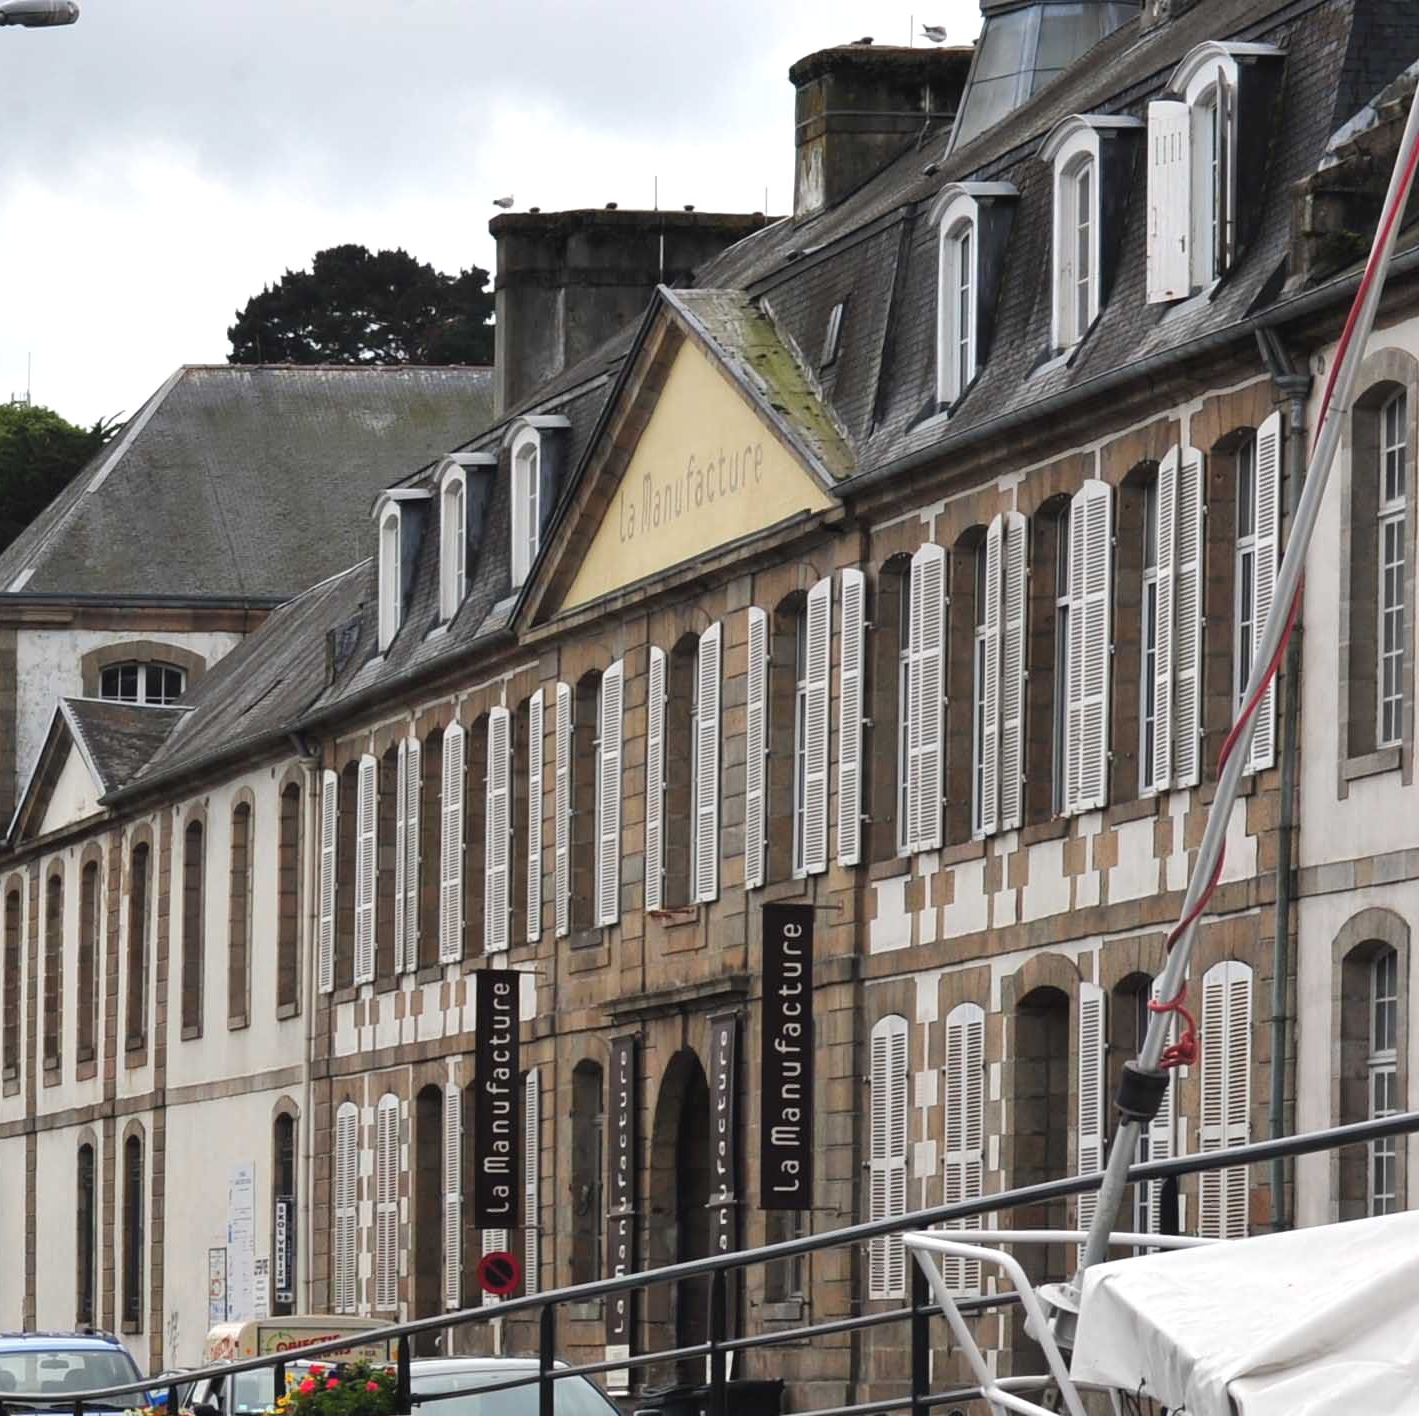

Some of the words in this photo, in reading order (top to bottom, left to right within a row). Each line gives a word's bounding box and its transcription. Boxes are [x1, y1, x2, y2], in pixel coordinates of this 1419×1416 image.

[641, 443, 764, 533] Manufacture
[484, 982, 510, 1174] Manufacture
[771, 922, 802, 1146] Manufacture
[486, 1185, 510, 1213] La
[716, 1030, 729, 1250] anufacture
[773, 1158, 800, 1192] La
